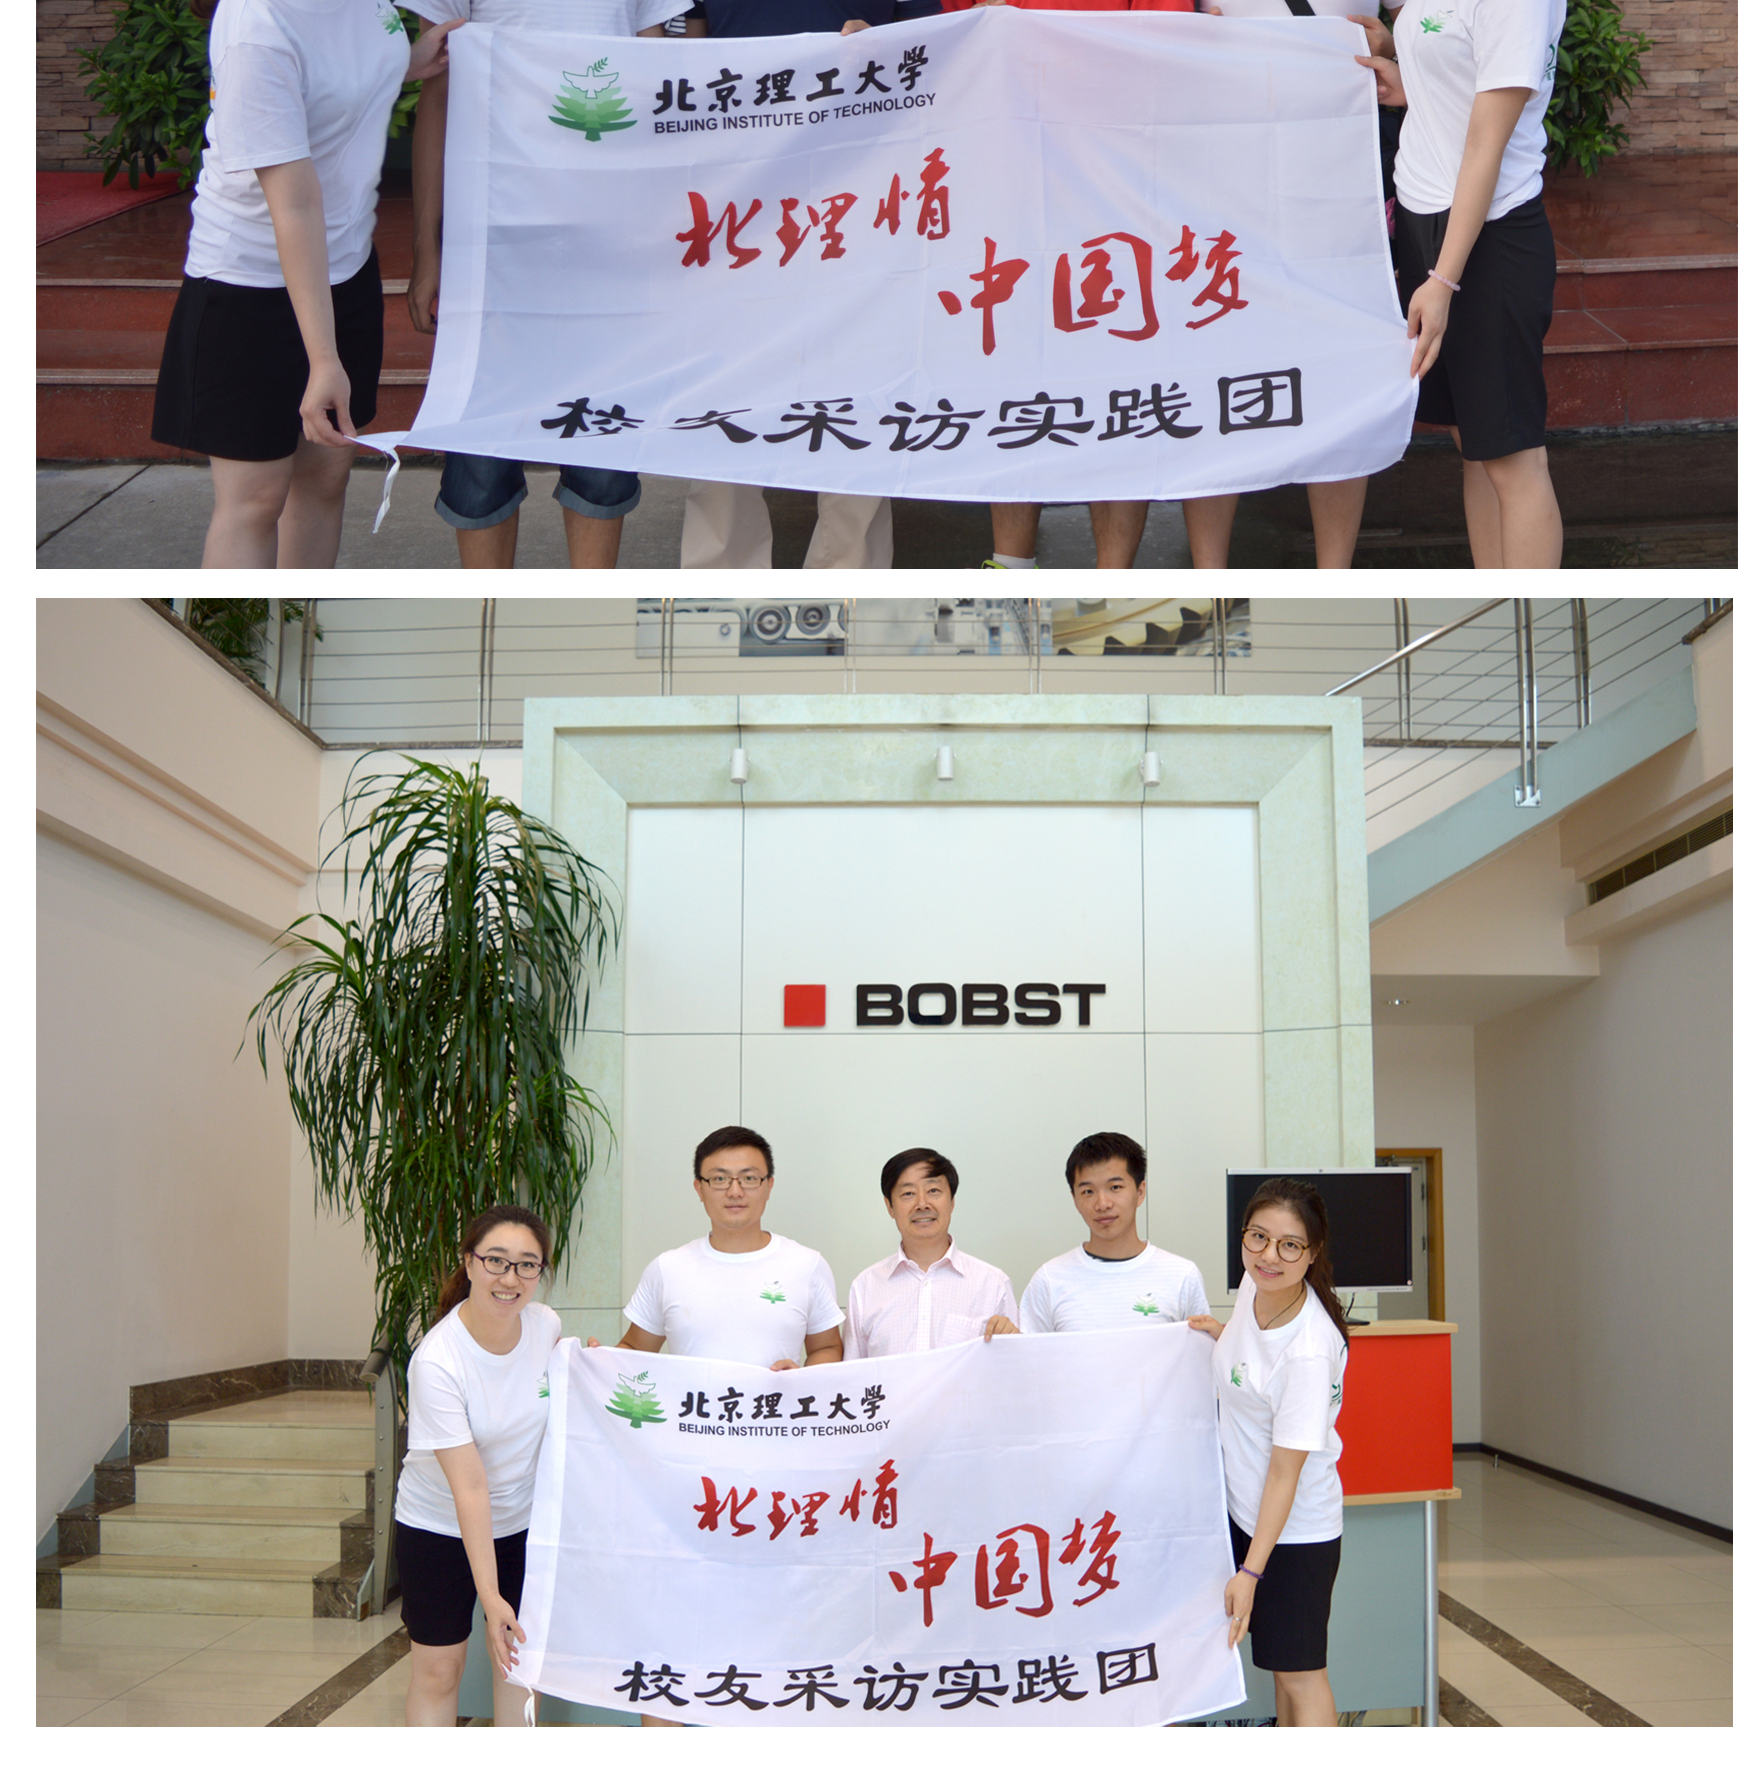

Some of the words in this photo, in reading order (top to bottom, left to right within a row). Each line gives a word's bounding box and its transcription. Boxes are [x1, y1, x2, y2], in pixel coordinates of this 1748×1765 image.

[654, 117, 718, 134] BEIJING
[723, 112, 804, 130] INSTITUTE
[808, 109, 829, 124] OF
[833, 93, 936, 119] TECHNOLOGY
[676, 148, 950, 268] 北理情
[938, 225, 1248, 355] 中国梦
[857, 983, 1106, 1026] BOBST
[678, 1422, 725, 1436] BEIJING
[728, 1425, 788, 1437] INSTITUTE
[791, 1426, 807, 1437] OF
[811, 1419, 891, 1436] TECHNOLOGY
[694, 1459, 898, 1540] 北理情
[889, 1511, 1121, 1627] 中国梦
[614, 1643, 1158, 1711] 校友采访实践团
